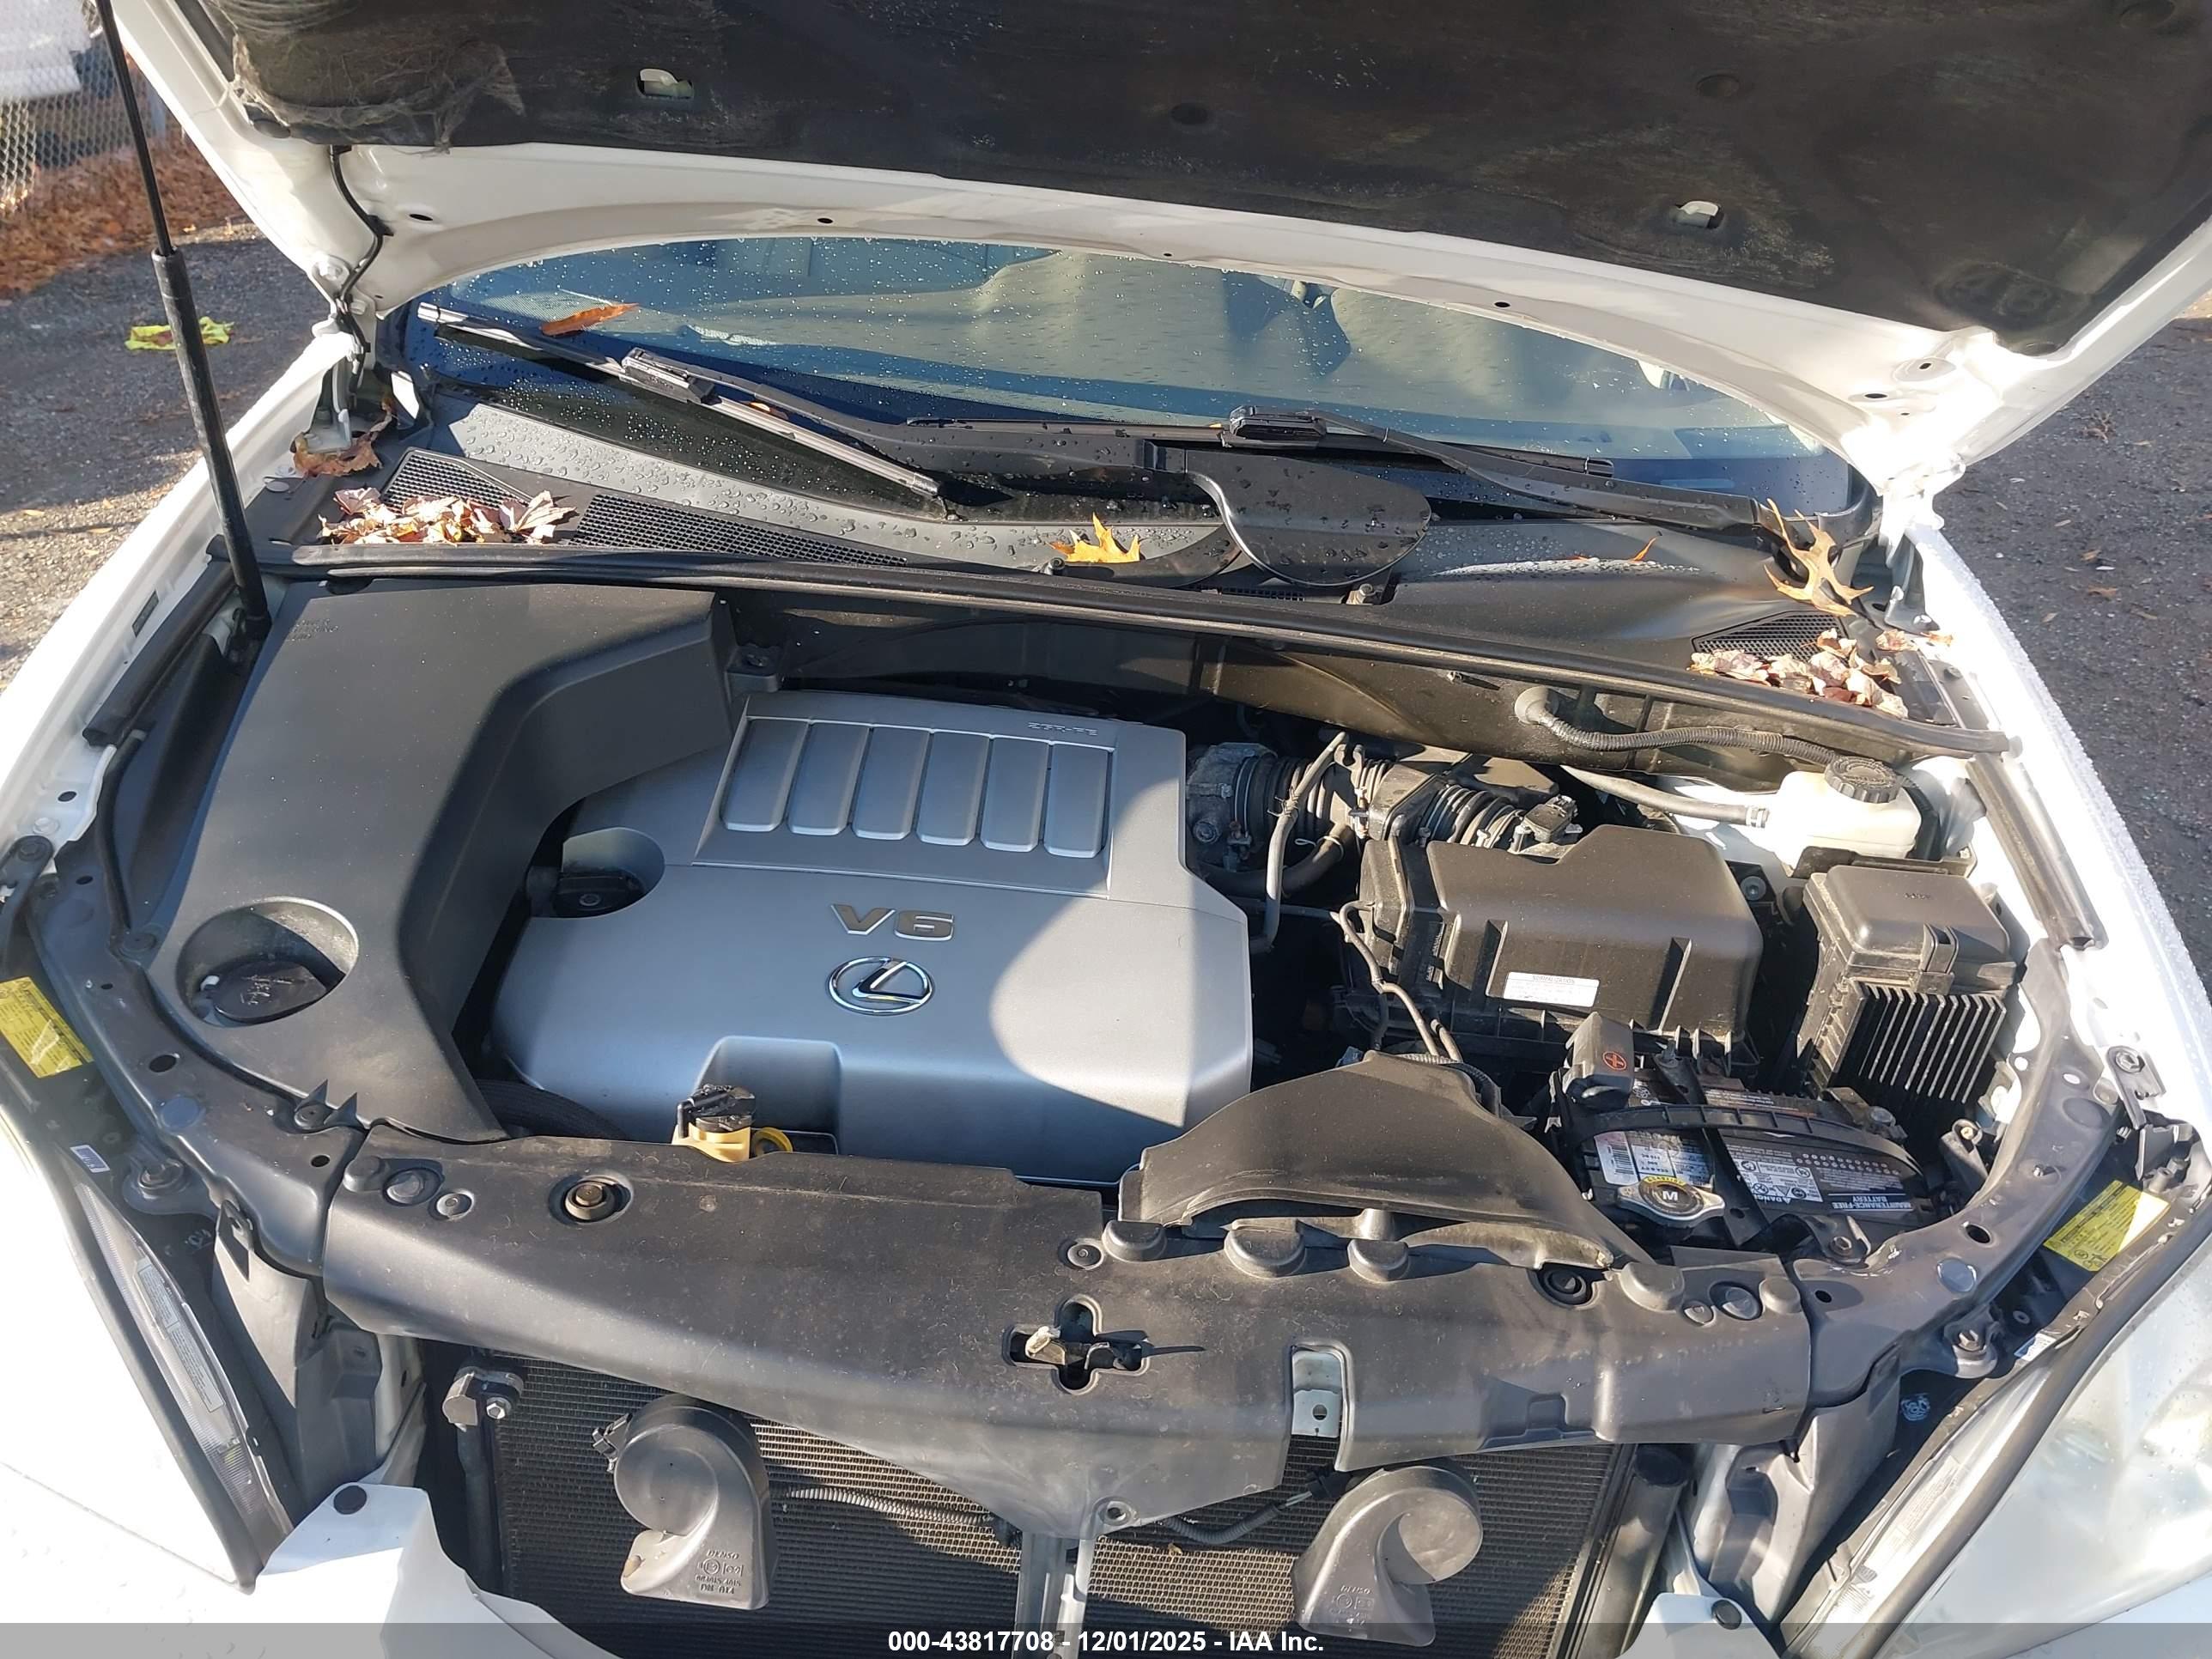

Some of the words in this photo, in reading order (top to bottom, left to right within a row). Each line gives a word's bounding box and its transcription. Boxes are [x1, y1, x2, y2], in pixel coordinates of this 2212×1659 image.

[830, 902, 955, 941] V6
[1851, 1194, 1888, 1203] BATTERY
[1831, 1201, 1911, 1210] MAINTENANCE-FREE
